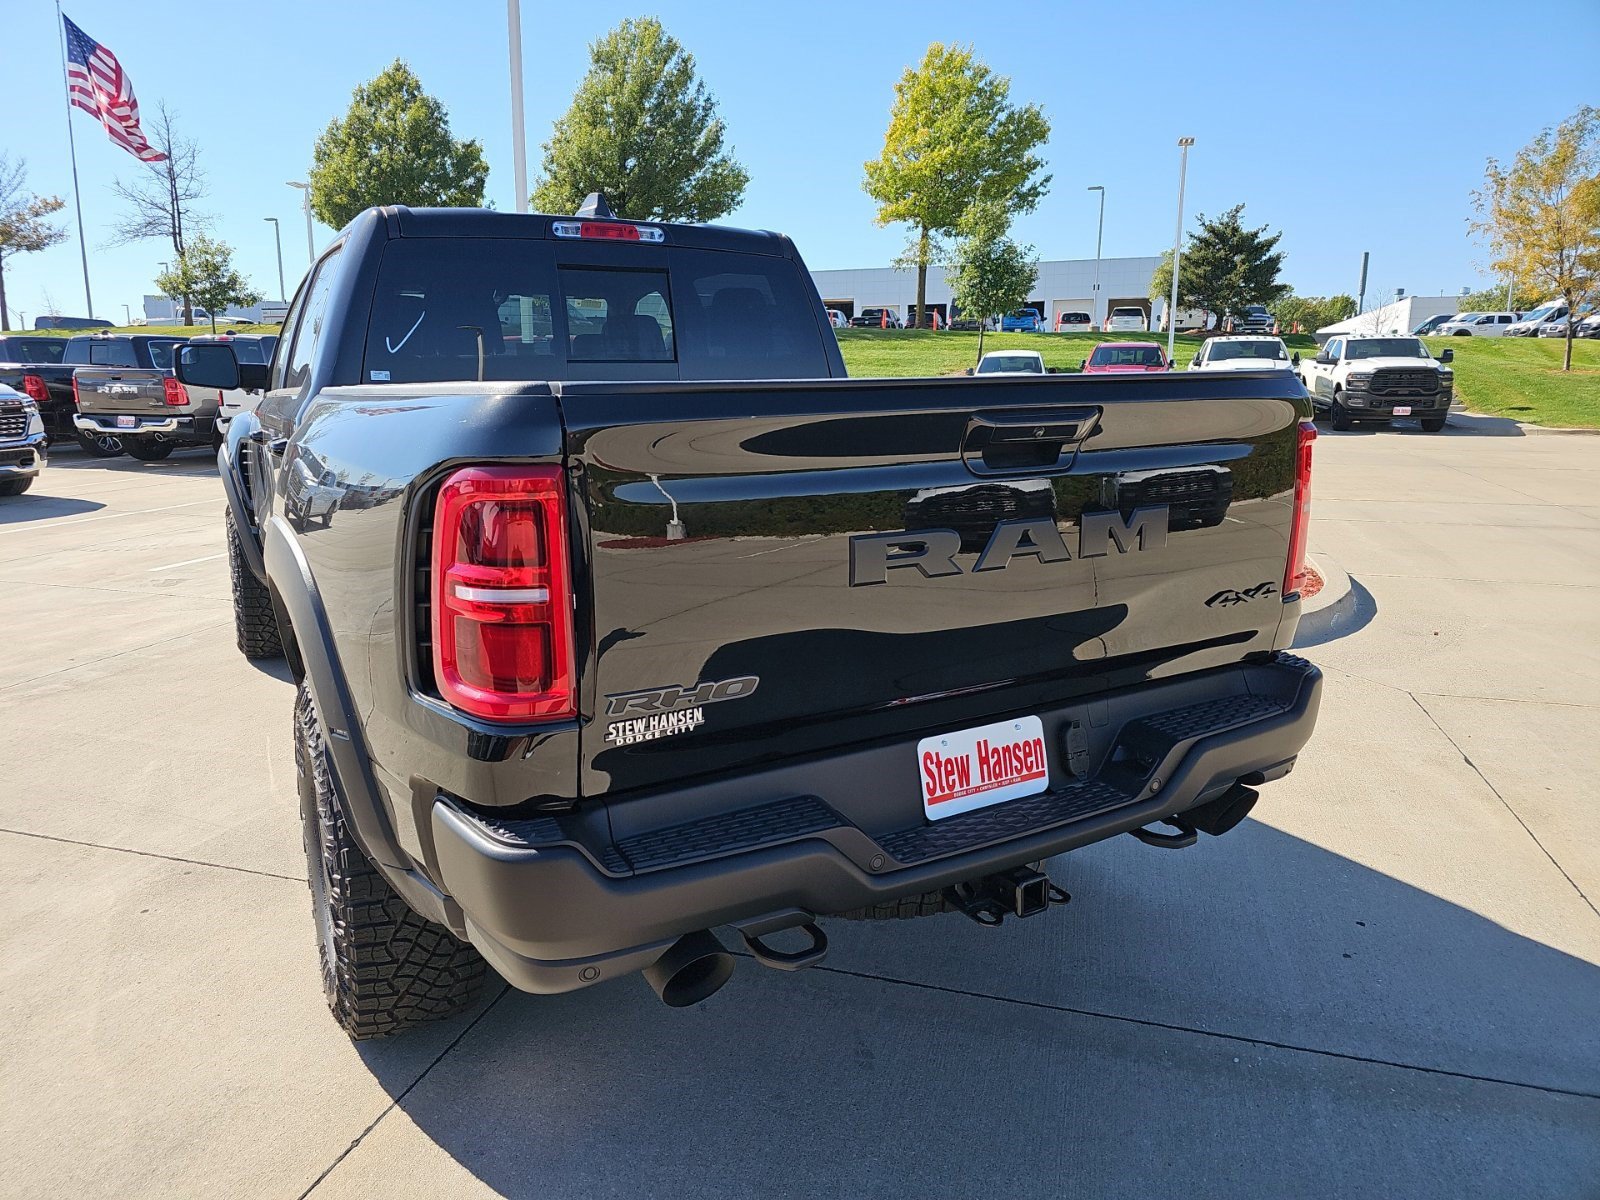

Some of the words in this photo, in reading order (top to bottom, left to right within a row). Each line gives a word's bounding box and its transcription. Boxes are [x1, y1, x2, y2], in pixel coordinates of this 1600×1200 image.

[97, 386, 138, 394] RAM
[849, 503, 1169, 587] RAM
[605, 676, 760, 718] RHO
[607, 718, 646, 738] STEW
[649, 707, 704, 731] HANSEN
[616, 731, 661, 746] DODGE
[666, 723, 696, 736] CITY
[922, 751, 971, 797] Stew
[976, 737, 1045, 783] Hansen
